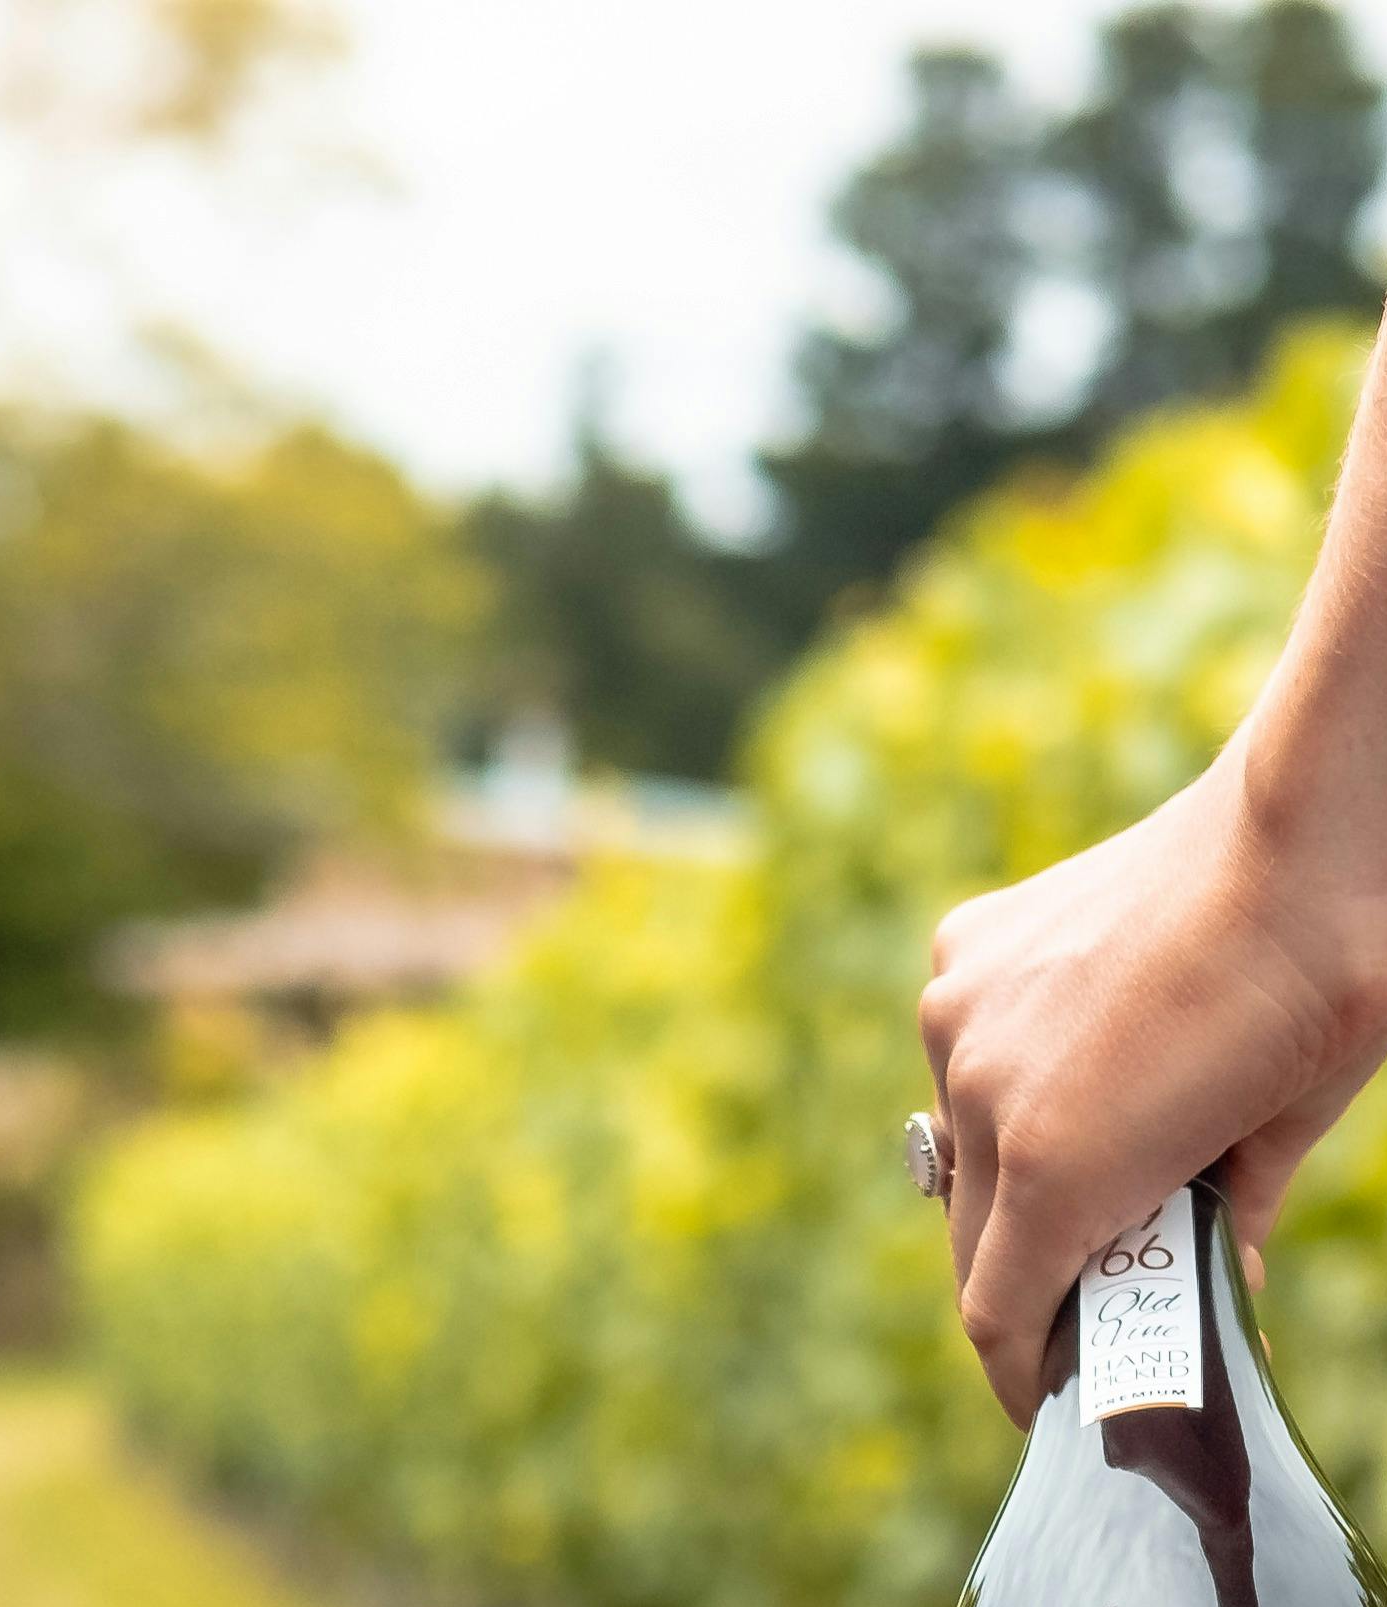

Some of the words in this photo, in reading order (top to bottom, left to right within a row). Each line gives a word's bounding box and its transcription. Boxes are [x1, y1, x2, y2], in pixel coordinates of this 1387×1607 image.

[1099, 1233, 1174, 1277] 66
[1098, 1287, 1182, 1322] Old
[1094, 1350, 1190, 1377] HAND
[1094, 1365, 1190, 1391] PICKED
[1094, 1389, 1186, 1409] PREMIUM
